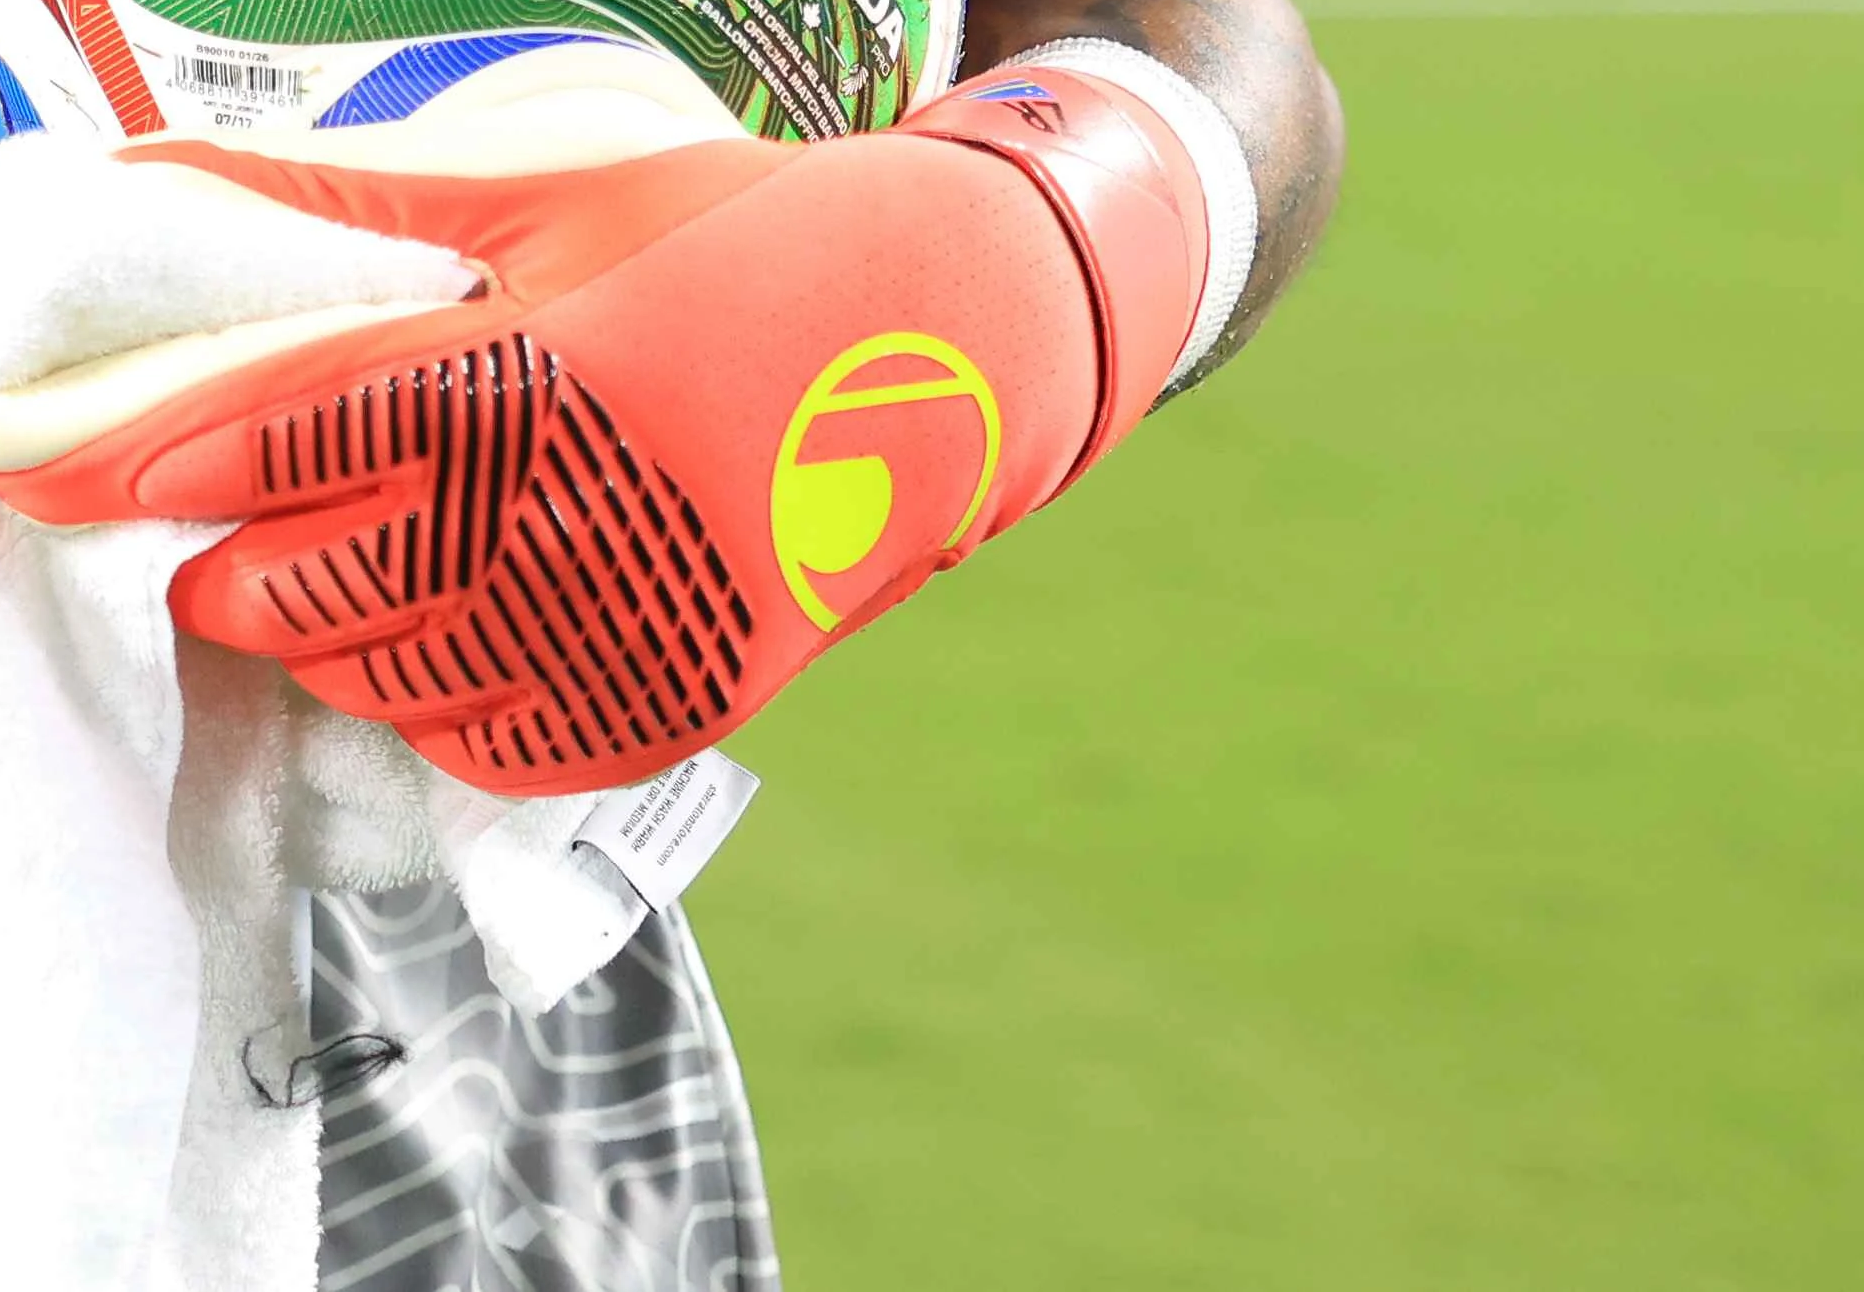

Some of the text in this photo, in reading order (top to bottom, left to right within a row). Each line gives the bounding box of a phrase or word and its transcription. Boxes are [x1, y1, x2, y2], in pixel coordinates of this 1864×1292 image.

[700, 0, 751, 55] BALLON
[748, 50, 764, 72] DE
[762, 66, 797, 114] MATCH
[743, 18, 836, 142] OFFICIAL MATCH BAL
[871, 47, 891, 77] PRO
[215, 112, 253, 129] 07/17
[801, 60, 820, 89] DEL
[816, 84, 849, 135] PARTIDO
[619, 801, 649, 838] MEDIUM
[631, 759, 699, 853] MACHINE WASH WARM
[644, 785, 662, 806] DRY
